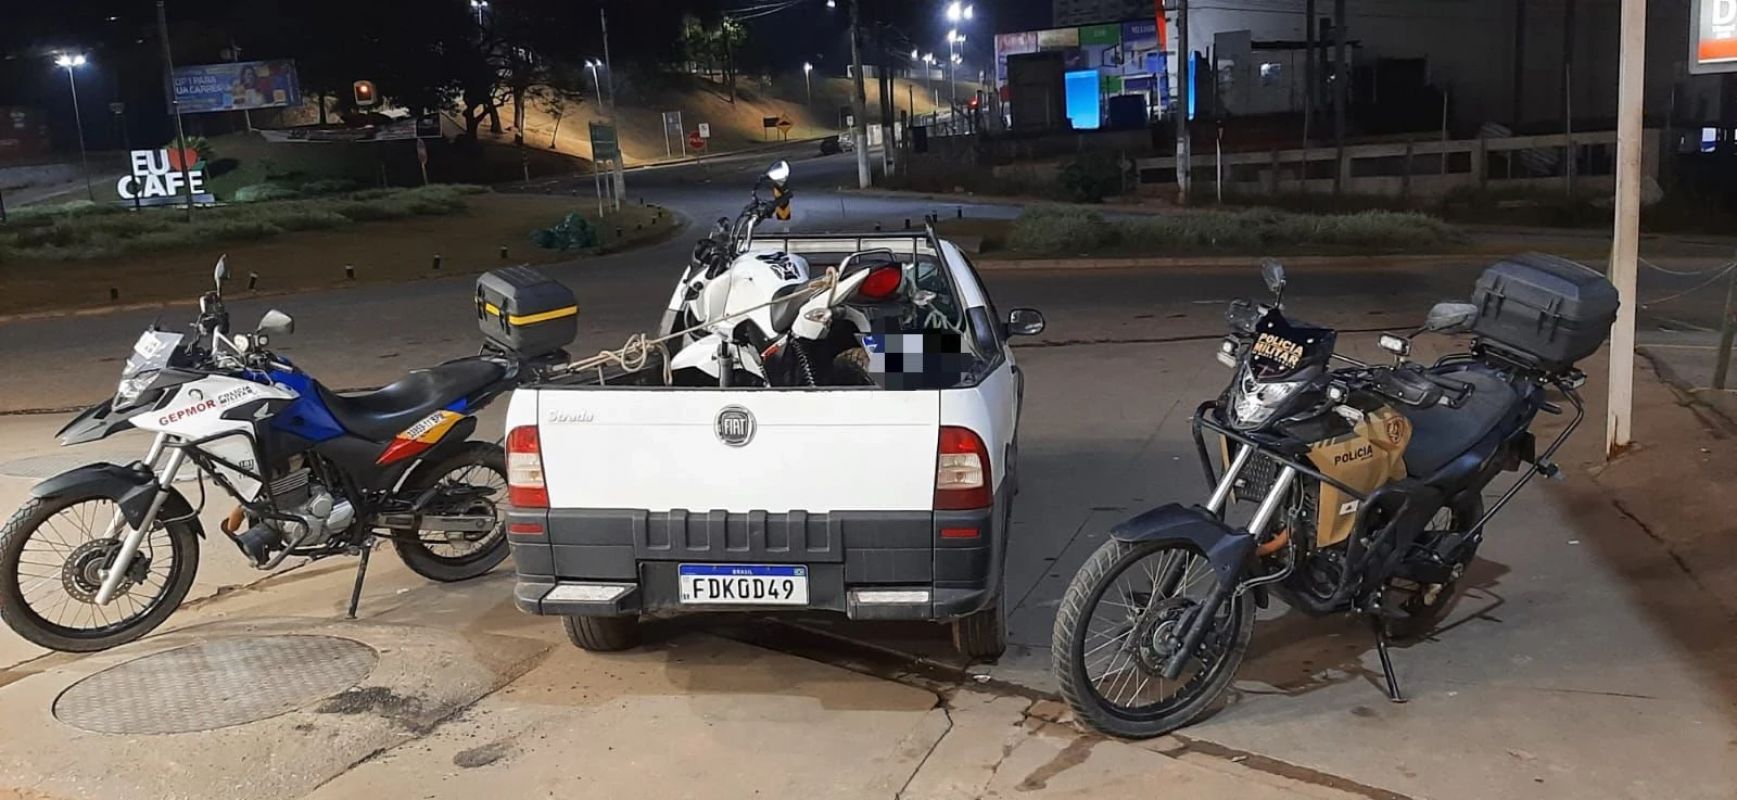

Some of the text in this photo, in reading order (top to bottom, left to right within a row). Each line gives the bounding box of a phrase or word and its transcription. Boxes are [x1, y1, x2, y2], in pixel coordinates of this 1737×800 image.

[130, 149, 171, 176] EU
[1252, 341, 1300, 366] MILITAR
[158, 399, 217, 427] GEPMOR
[547, 408, 594, 422] Strada
[724, 418, 746, 435] FIAT
